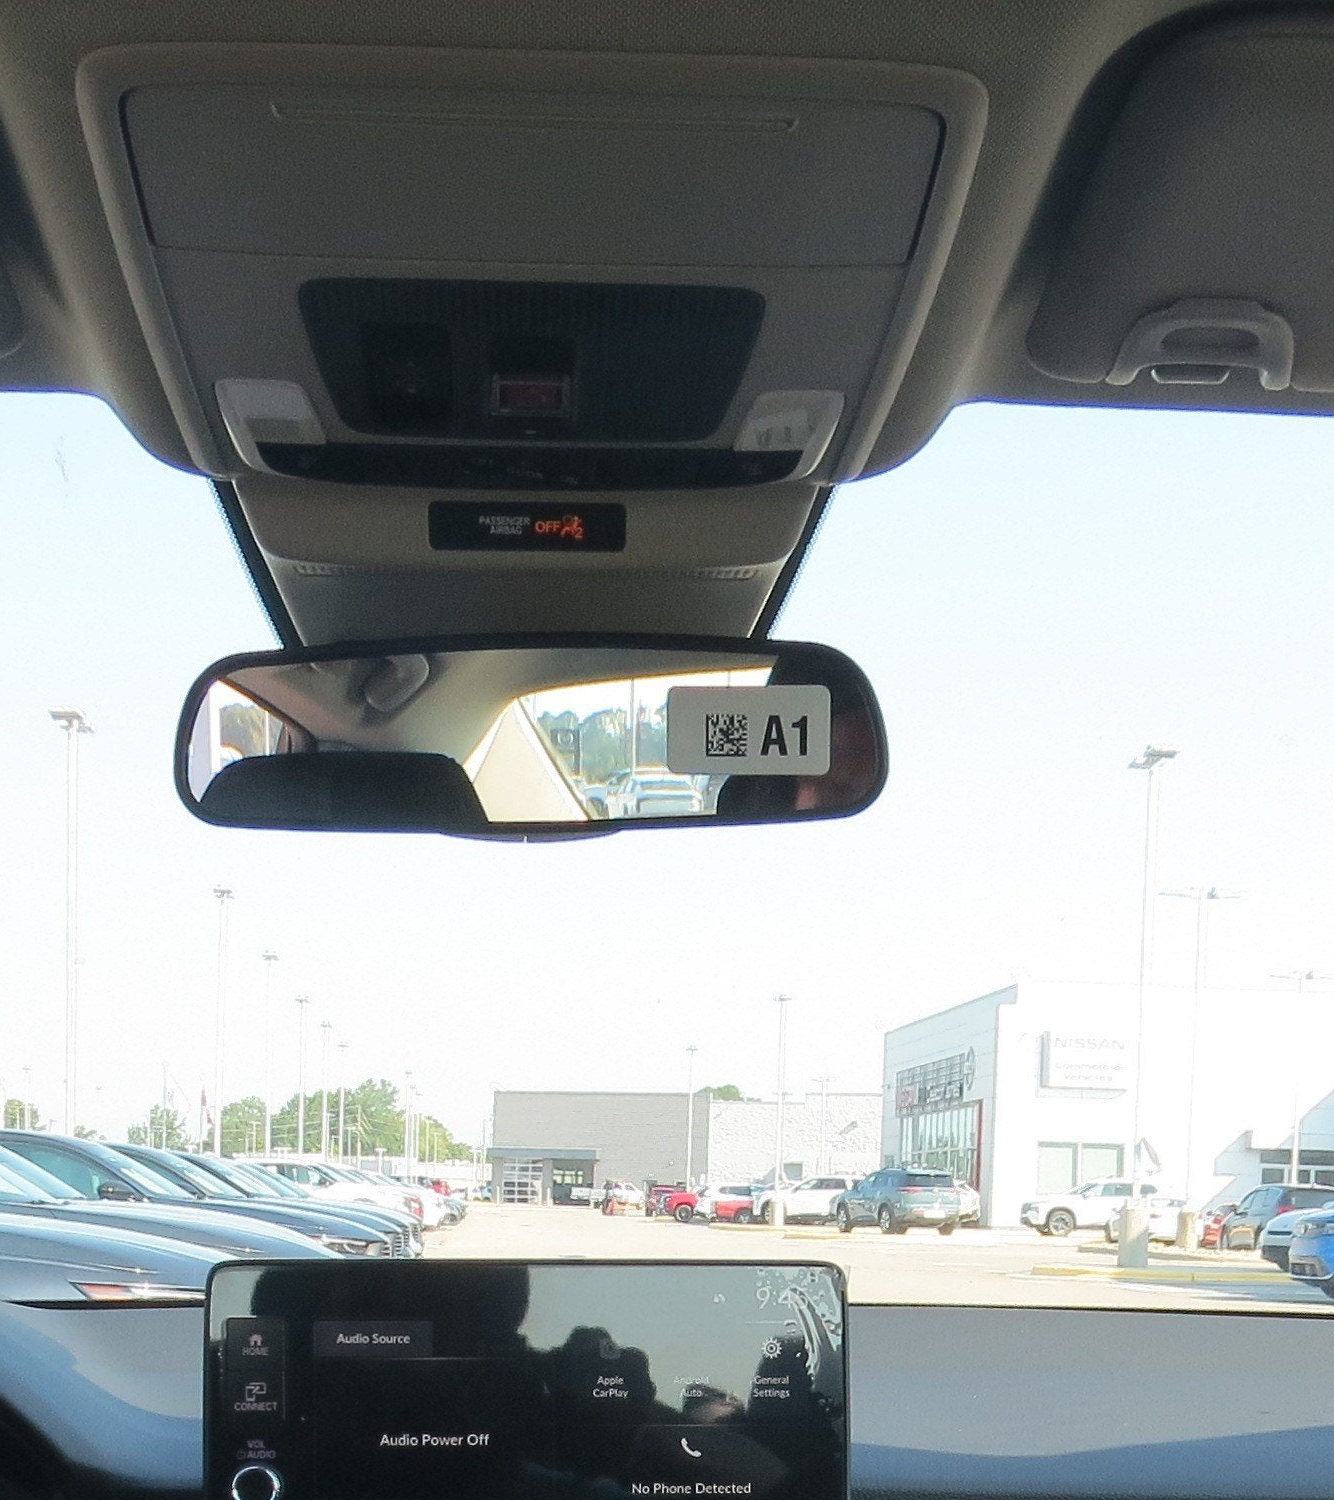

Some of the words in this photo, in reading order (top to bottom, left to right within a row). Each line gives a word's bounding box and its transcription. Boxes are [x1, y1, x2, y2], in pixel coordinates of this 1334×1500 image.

[479, 515, 530, 526] PASSENGER
[535, 520, 561, 532] OFF
[760, 714, 808, 756] A1
[1053, 1037, 1125, 1049] NISSAN
[336, 1333, 370, 1345] Audio
[372, 1333, 411, 1345] Source
[242, 1346, 269, 1356] HOME
[596, 1375, 624, 1387] Apple
[753, 1375, 790, 1386] General
[592, 1388, 629, 1400] CarPlay
[753, 1388, 791, 1400] Settings
[234, 1401, 278, 1411] CONNECT
[247, 1439, 266, 1449] VOL
[380, 1433, 419, 1446] Audio
[422, 1433, 464, 1446] Power
[466, 1433, 490, 1446] Off
[247, 1450, 276, 1459] AUDIO
[631, 1483, 650, 1494] No
[653, 1482, 691, 1494] Phone
[695, 1482, 752, 1494] Detected
